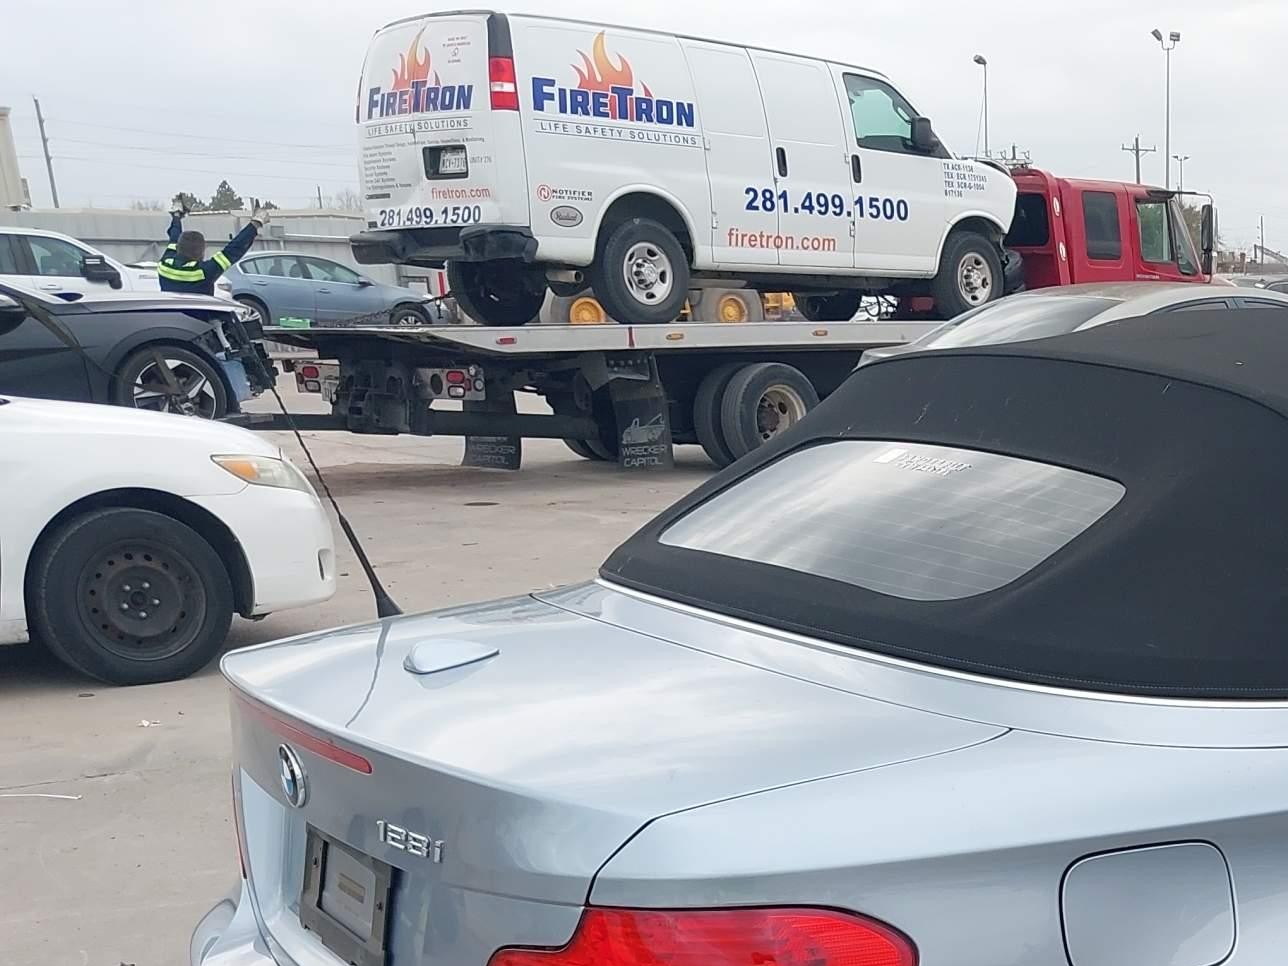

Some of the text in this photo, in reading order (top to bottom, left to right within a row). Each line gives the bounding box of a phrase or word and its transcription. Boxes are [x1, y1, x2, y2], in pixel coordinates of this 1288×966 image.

[367, 127, 382, 137] LIFE
[417, 118, 469, 130] SOLUTIONS
[540, 121, 697, 145] LIFE SAFETY SOLUTIONS
[431, 187, 491, 200] firetron.com
[552, 189, 593, 197] NOTIFIER
[743, 186, 909, 222] 281.499.1500
[379, 205, 482, 227] 281.499.1500
[727, 227, 837, 252] firetron.com
[376, 820, 445, 863] 128i
